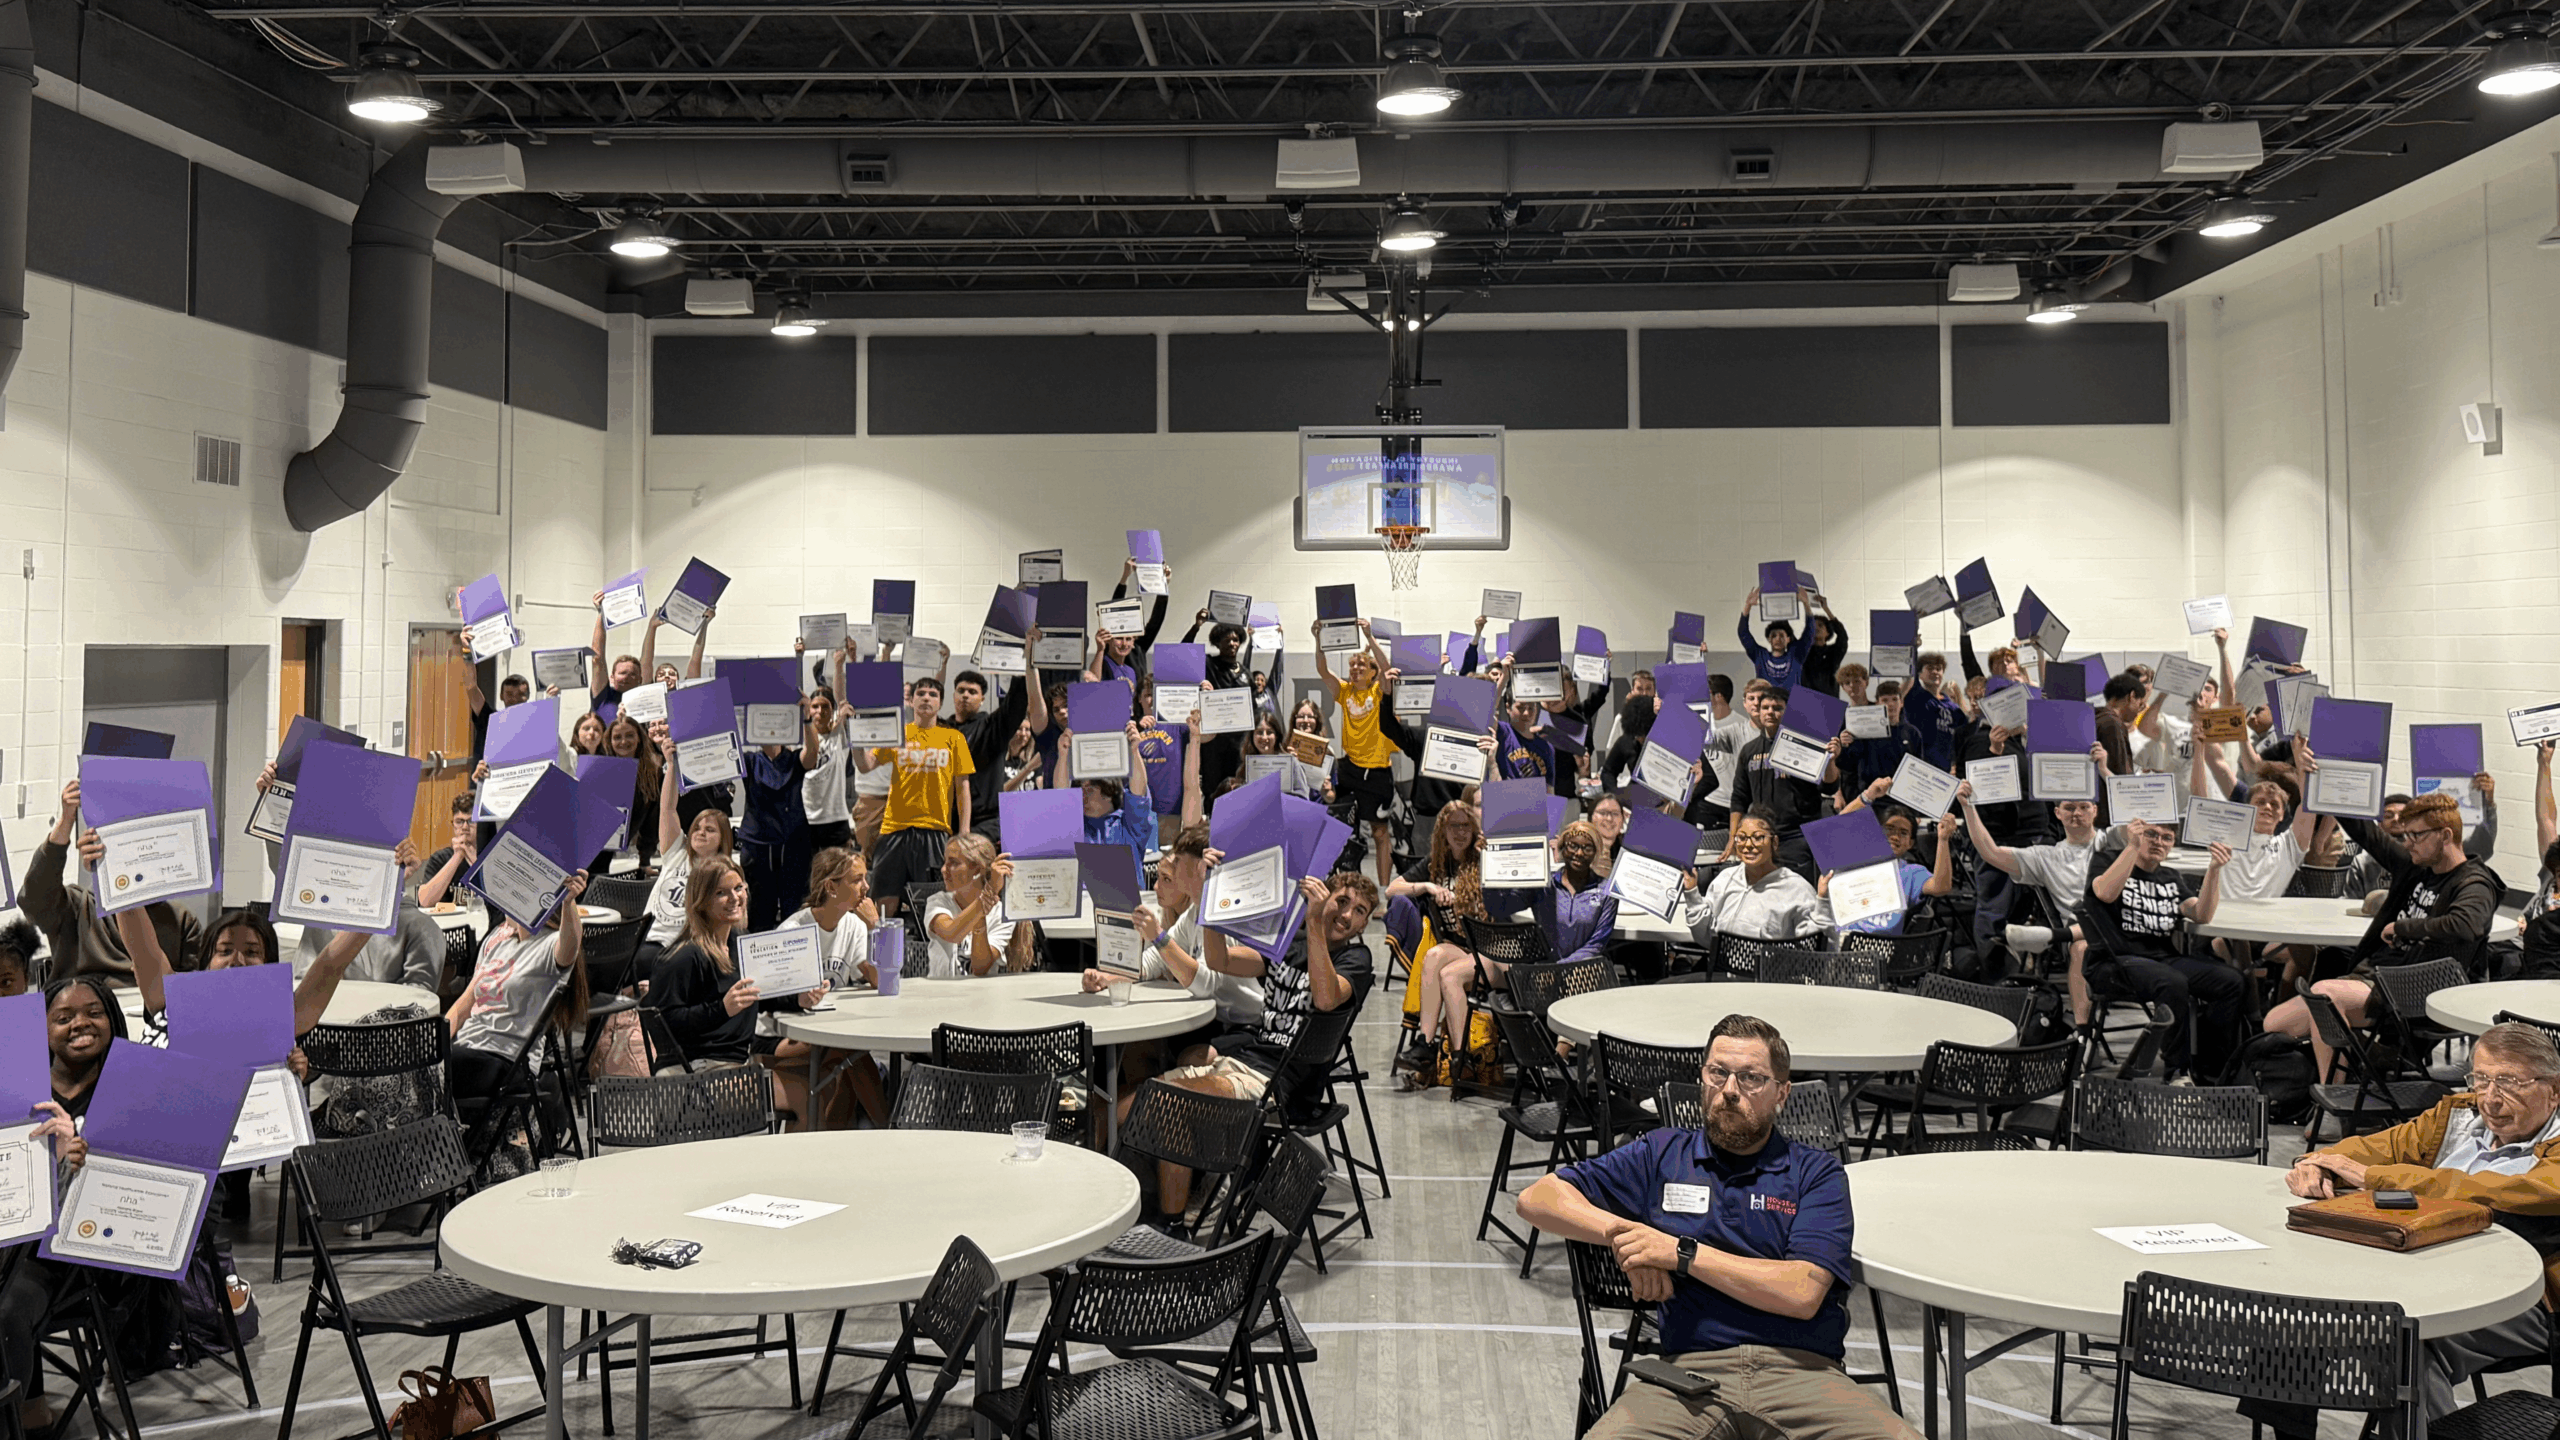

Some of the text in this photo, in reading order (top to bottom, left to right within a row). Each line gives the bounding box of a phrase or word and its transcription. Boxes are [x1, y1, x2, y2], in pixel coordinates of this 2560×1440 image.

[119, 1195, 138, 1205] nha
[716, 1205, 804, 1221] Reserved
[2132, 1236, 2239, 1246] Reserved
